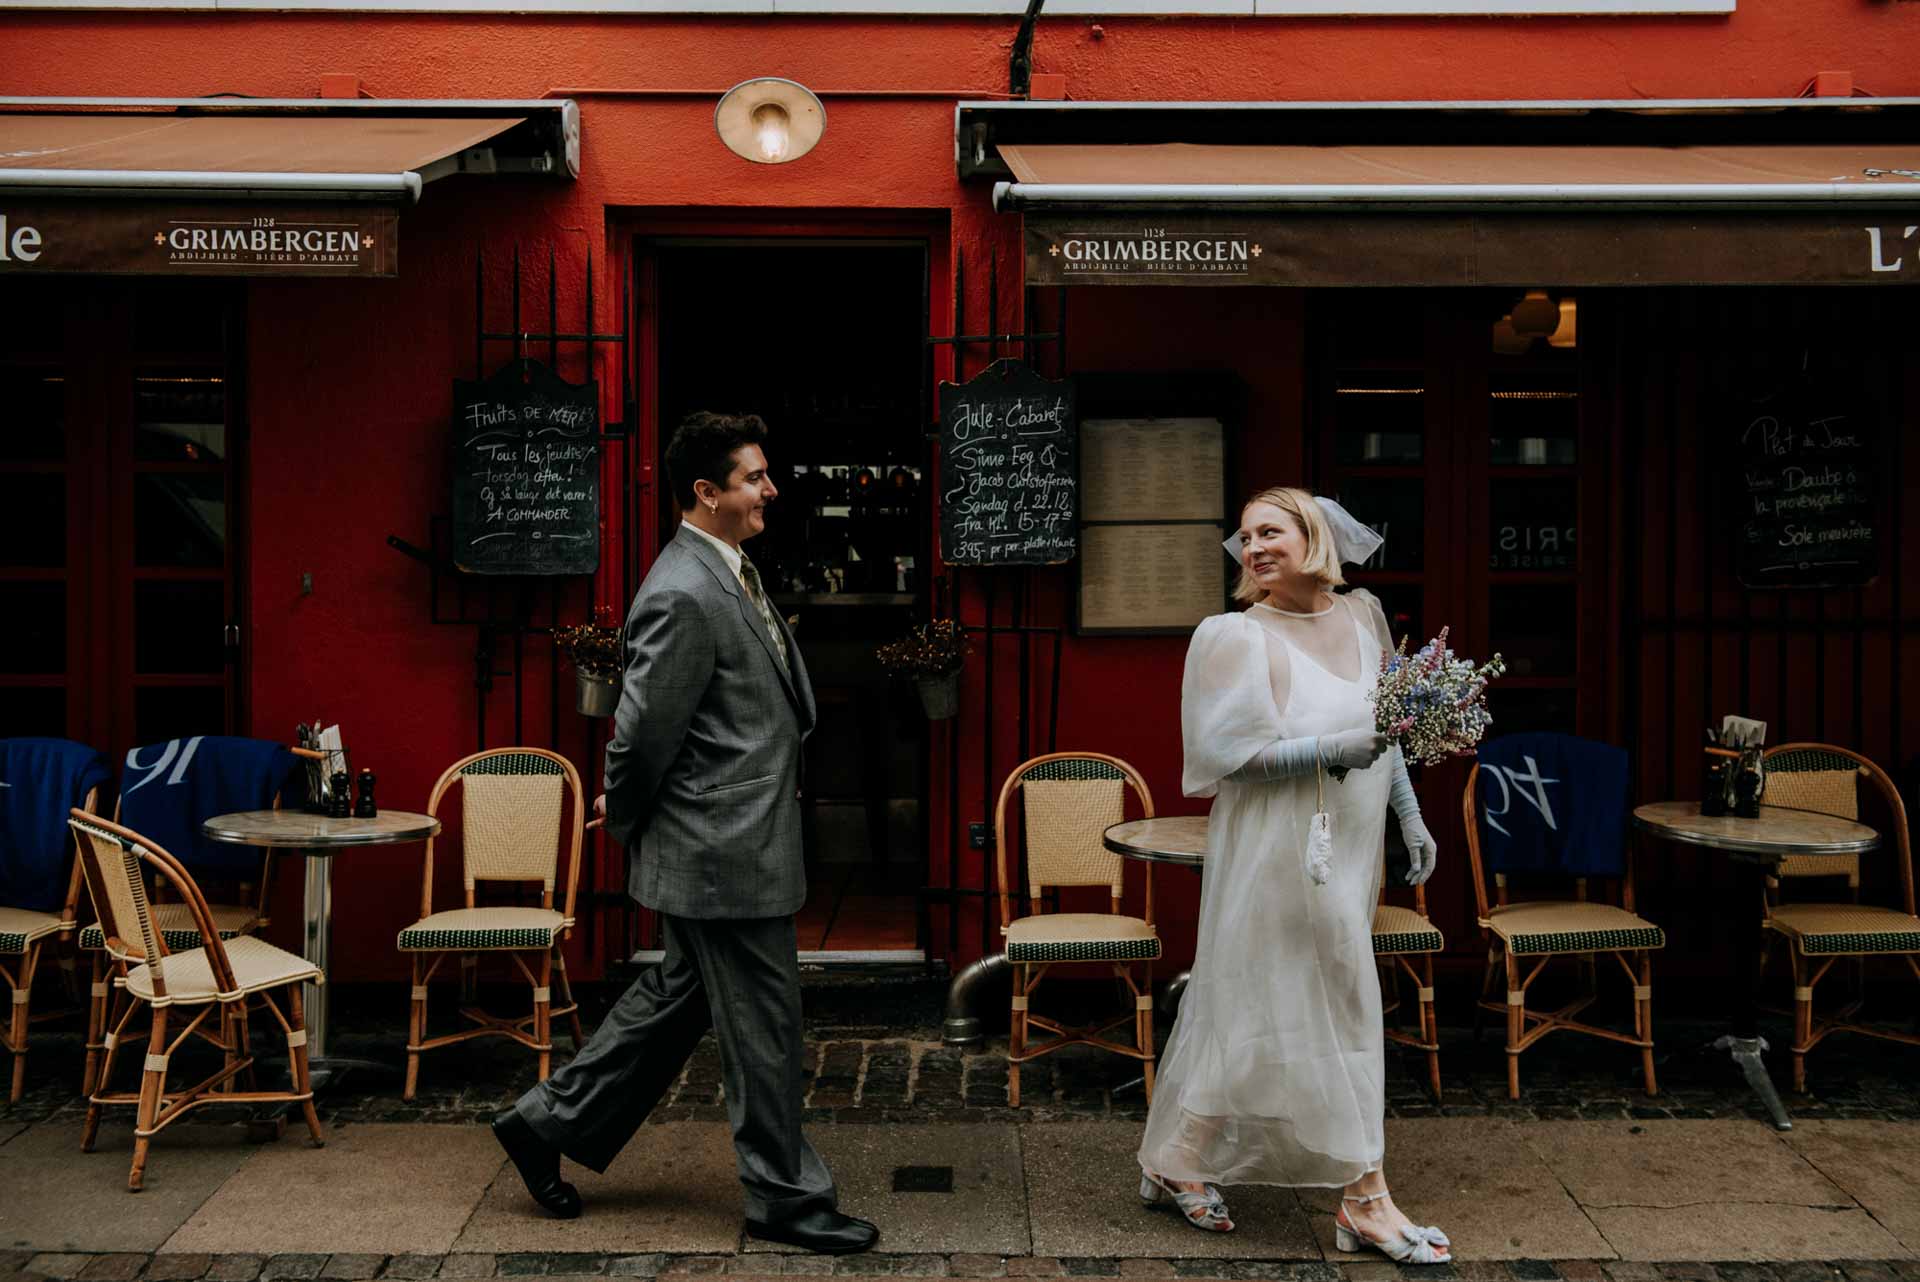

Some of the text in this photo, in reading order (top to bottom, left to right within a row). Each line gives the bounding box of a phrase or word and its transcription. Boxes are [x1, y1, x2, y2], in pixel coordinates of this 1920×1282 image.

[253, 217, 275, 228] 1128
[1144, 228, 1166, 238] 1128
[169, 228, 359, 252] GRIMBERGEN
[1063, 240, 1248, 261] GRIMBERGEN
[1864, 226, 1920, 272] L'
[170, 252, 237, 260] ABDIJBIER
[465, 402, 517, 429] Fruits
[476, 443, 517, 461] Tous
[524, 443, 540, 463] les
[954, 447, 1006, 471] Sinne
[968, 472, 1004, 496] Jacob
[480, 486, 495, 510] Og
[545, 486, 560, 500] det
[506, 508, 571, 522] COMMANDER
